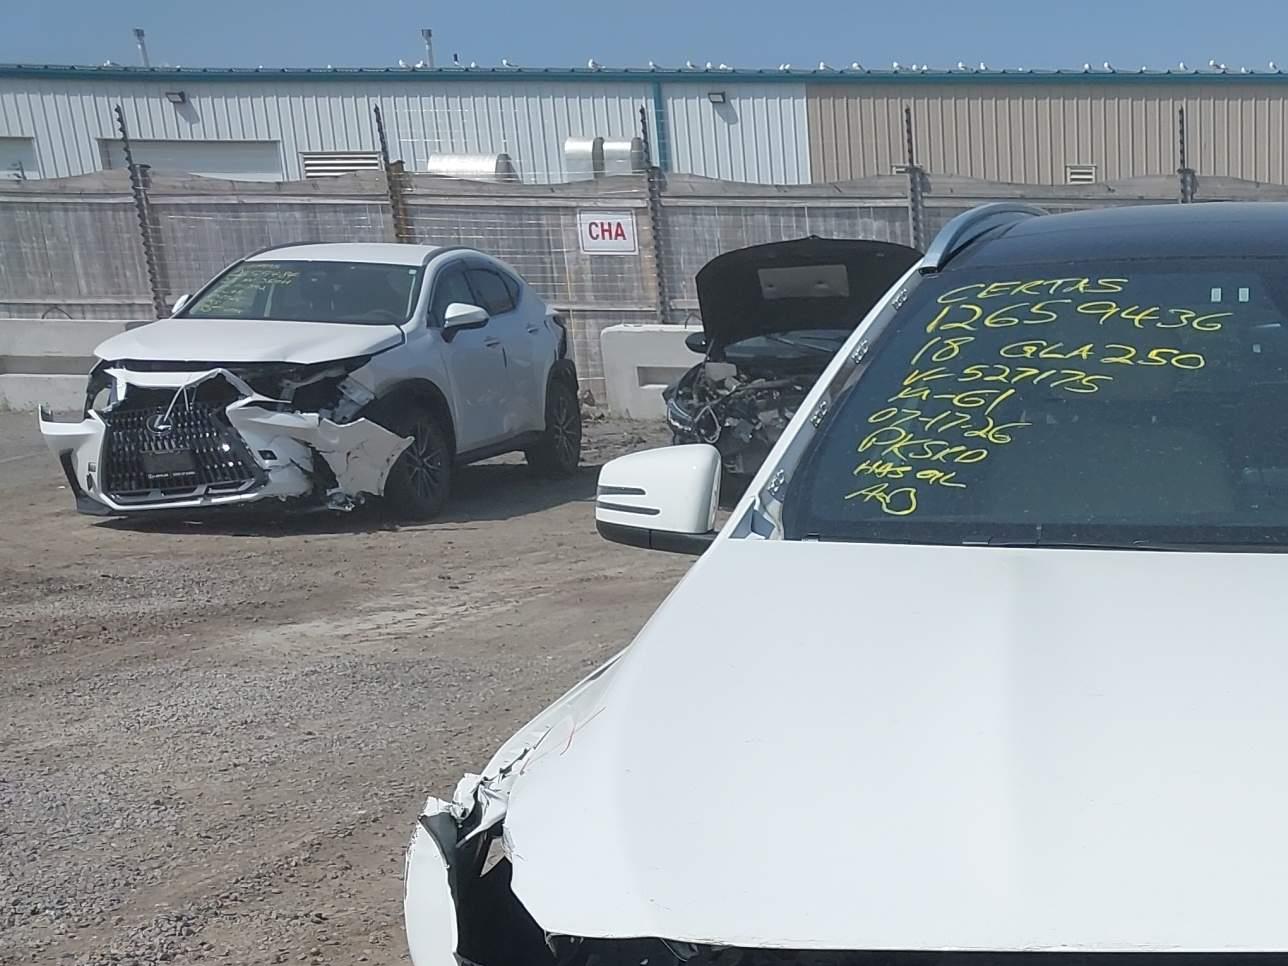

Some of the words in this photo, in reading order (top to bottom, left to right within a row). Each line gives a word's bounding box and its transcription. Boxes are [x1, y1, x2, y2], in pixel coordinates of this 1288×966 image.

[588, 221, 627, 240] CHA
[937, 278, 1128, 303] CERTAS
[912, 337, 975, 365] 18
